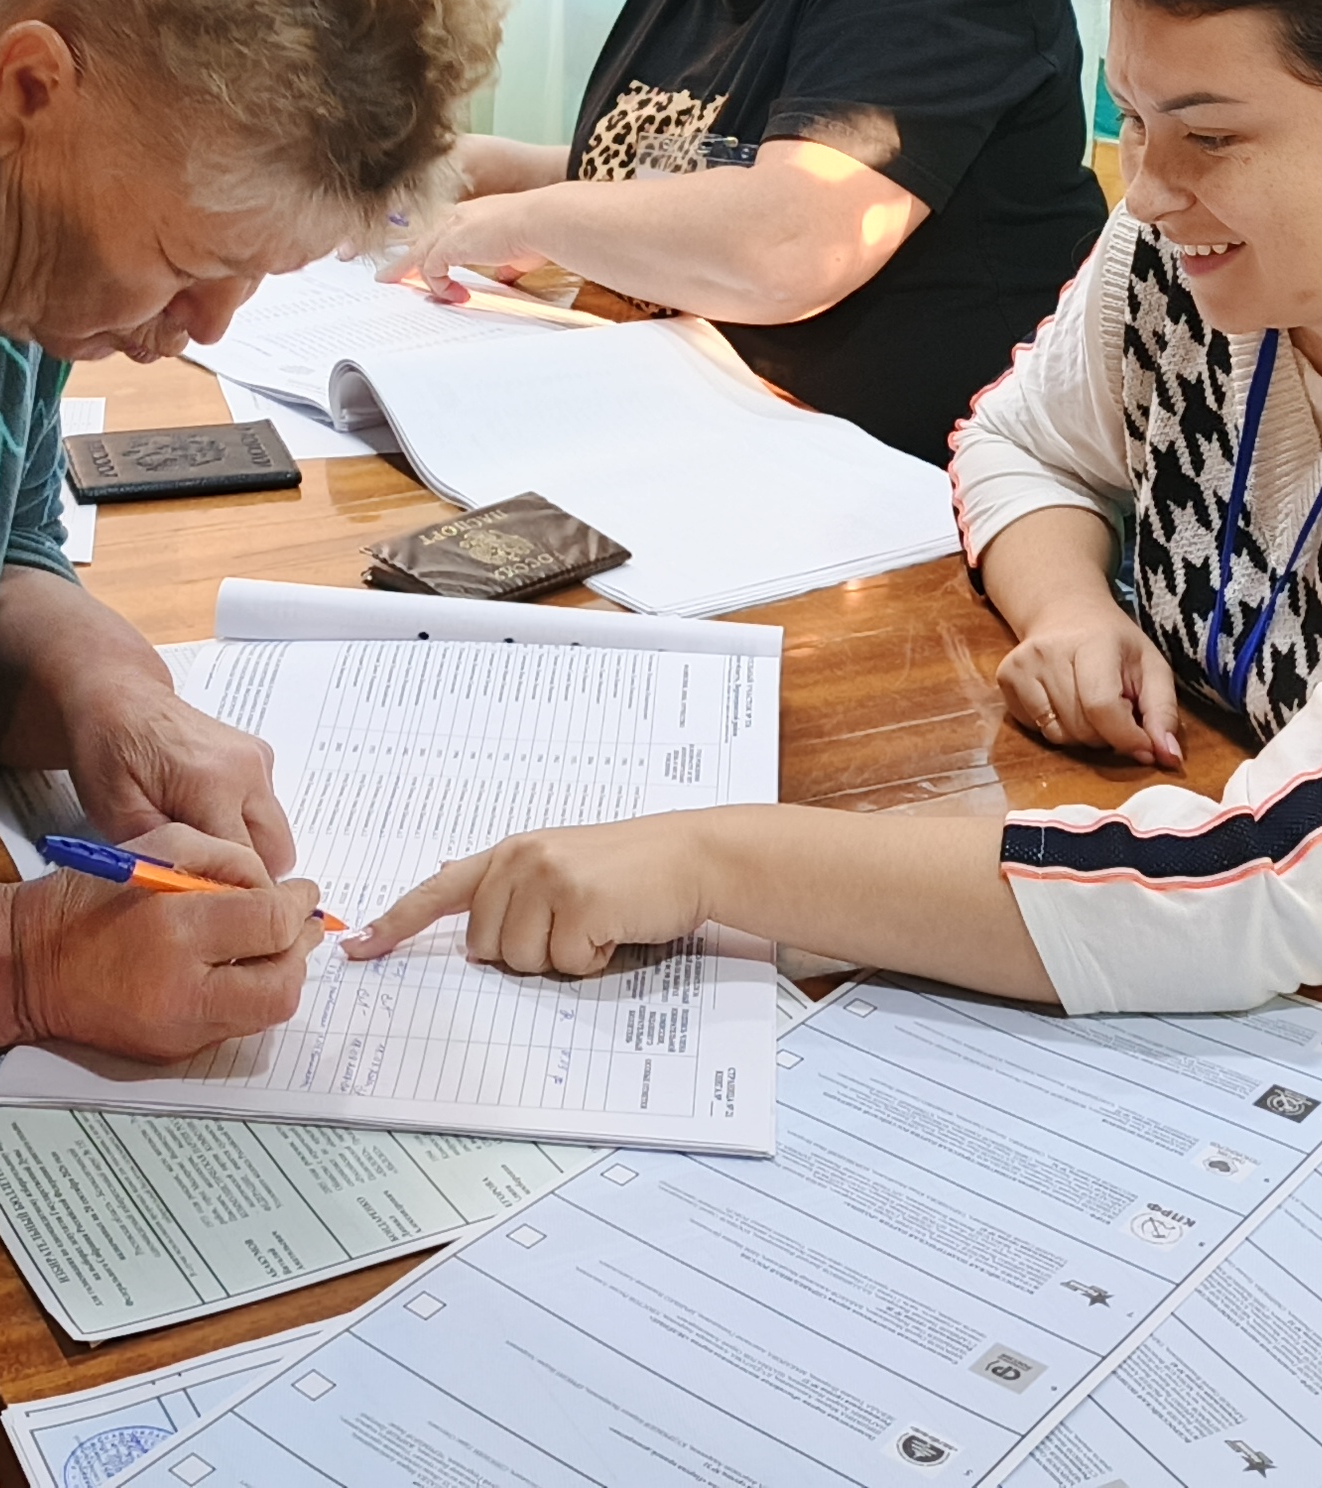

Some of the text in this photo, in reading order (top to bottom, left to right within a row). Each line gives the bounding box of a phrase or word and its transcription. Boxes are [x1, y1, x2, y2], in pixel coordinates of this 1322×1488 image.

[418, 508, 508, 547] ПАСПОРТ
[356, 1192, 399, 1245] БОНДАРЕНКО
[1144, 1197, 1196, 1231] КПРФ
[15, 1208, 70, 1287] ИЗБИРАТЕЛЬНЫЙ
[989, 1358, 1022, 1386] СР
